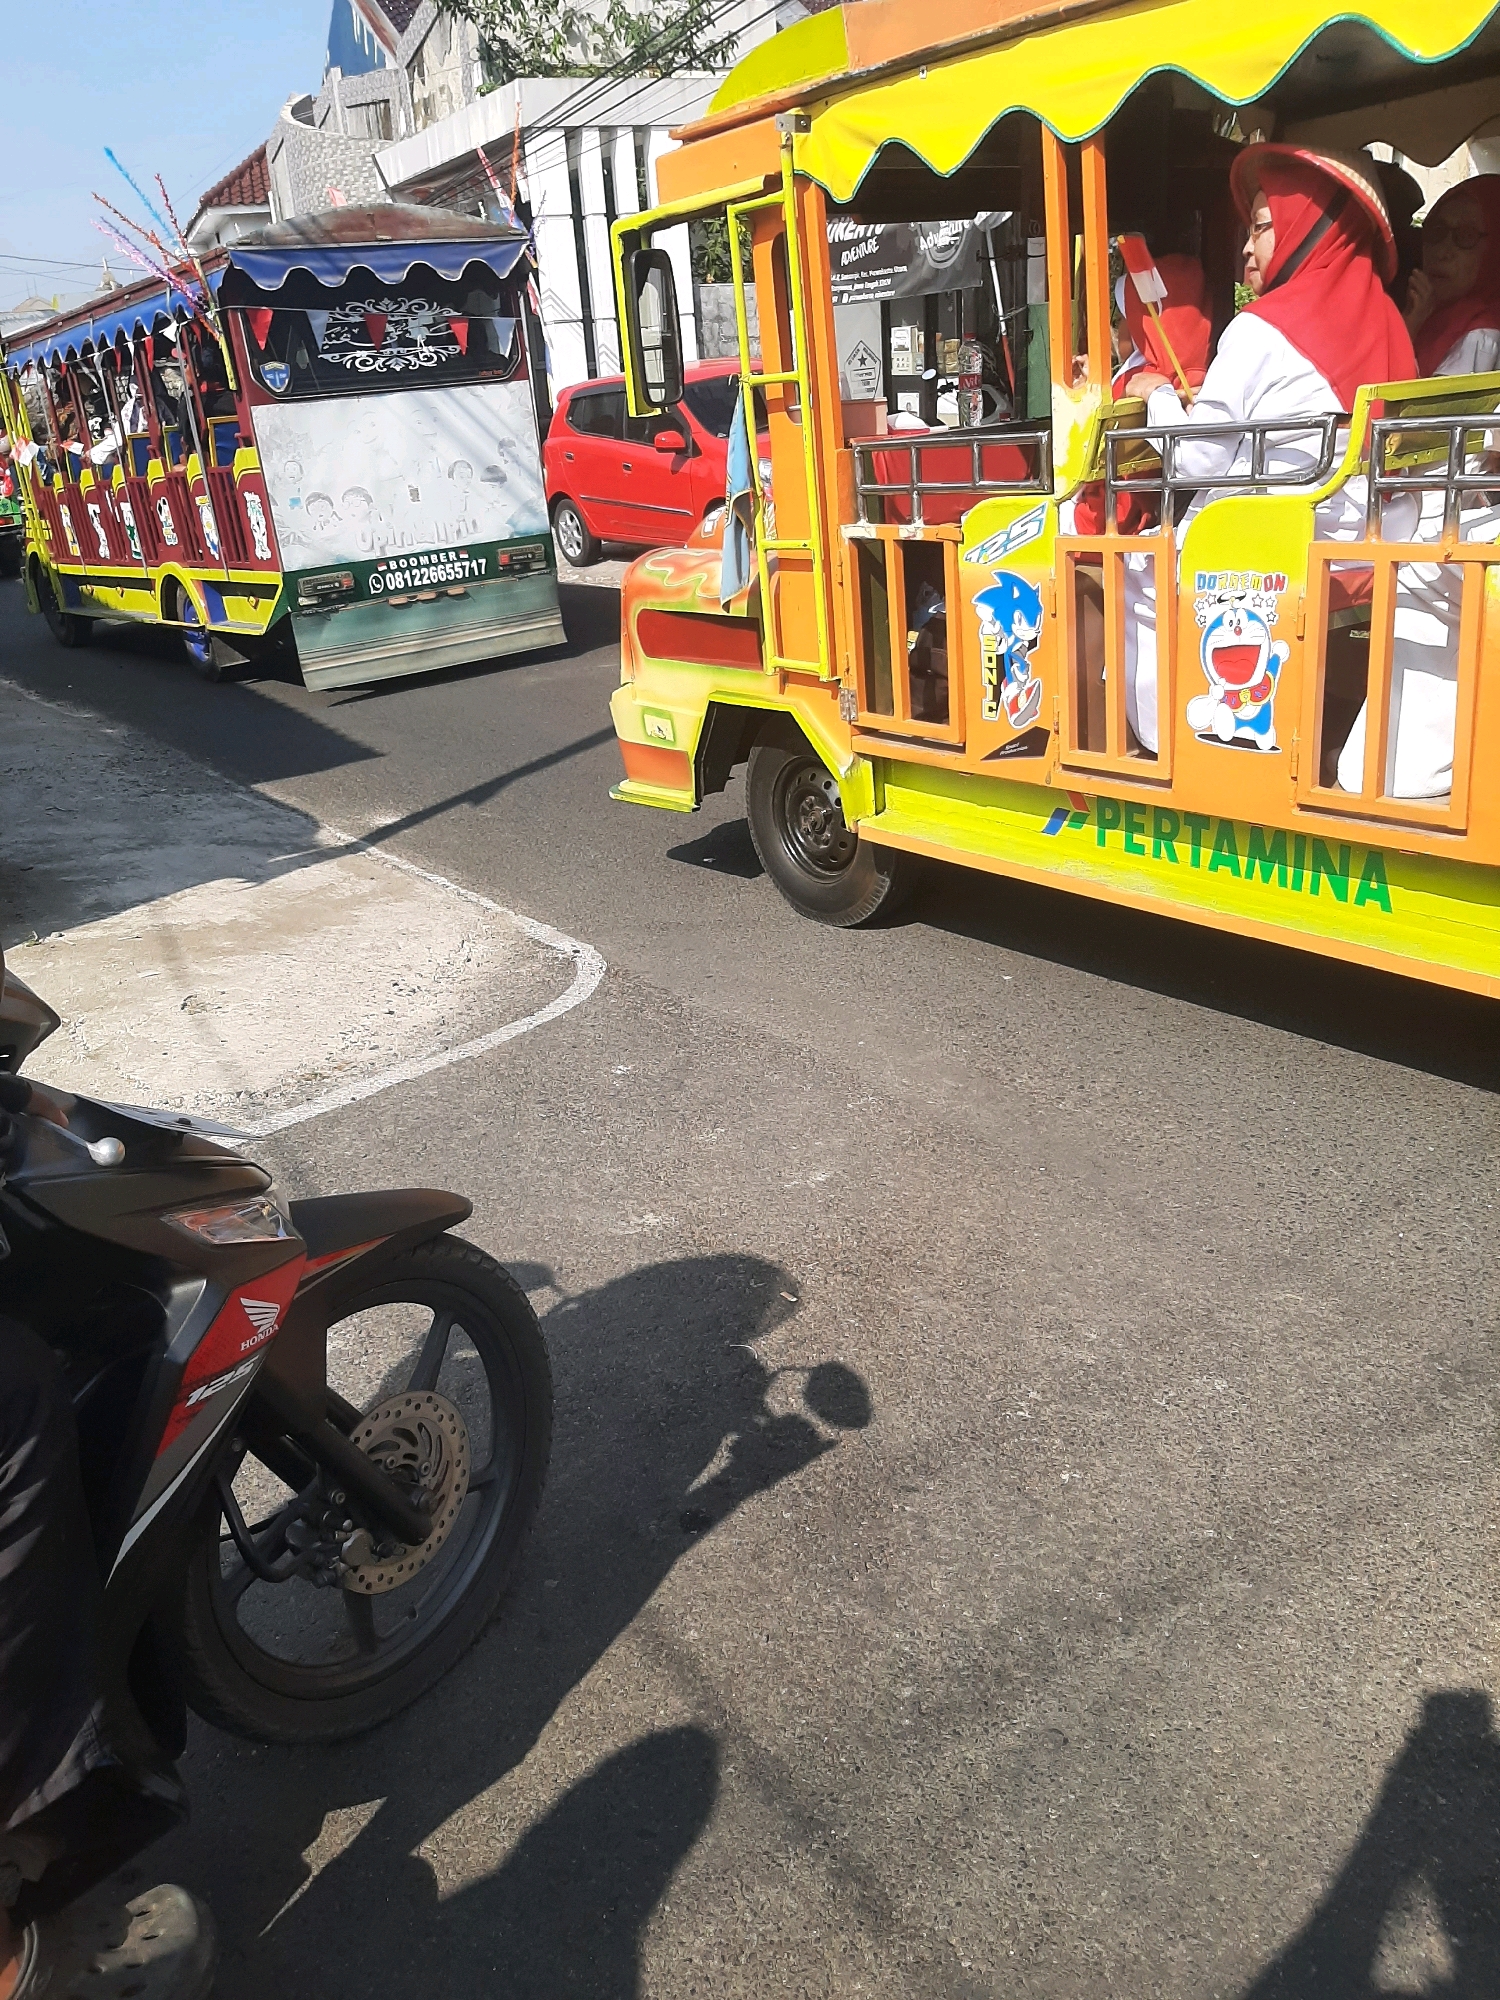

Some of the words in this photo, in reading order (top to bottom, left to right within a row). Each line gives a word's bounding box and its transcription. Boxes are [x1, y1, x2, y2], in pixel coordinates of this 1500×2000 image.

[840, 235, 880, 267] ADVENTURE
[963, 501, 1049, 565] 125
[386, 558, 487, 591] 081226655717
[389, 552, 458, 570] BOOMBER
[1197, 573, 1286, 592] DORAEMON
[983, 634, 998, 719] SONIC
[1096, 795, 1394, 915] PERTAMINA
[240, 1324, 280, 1352] HONDA
[185, 1355, 260, 1408] 125
